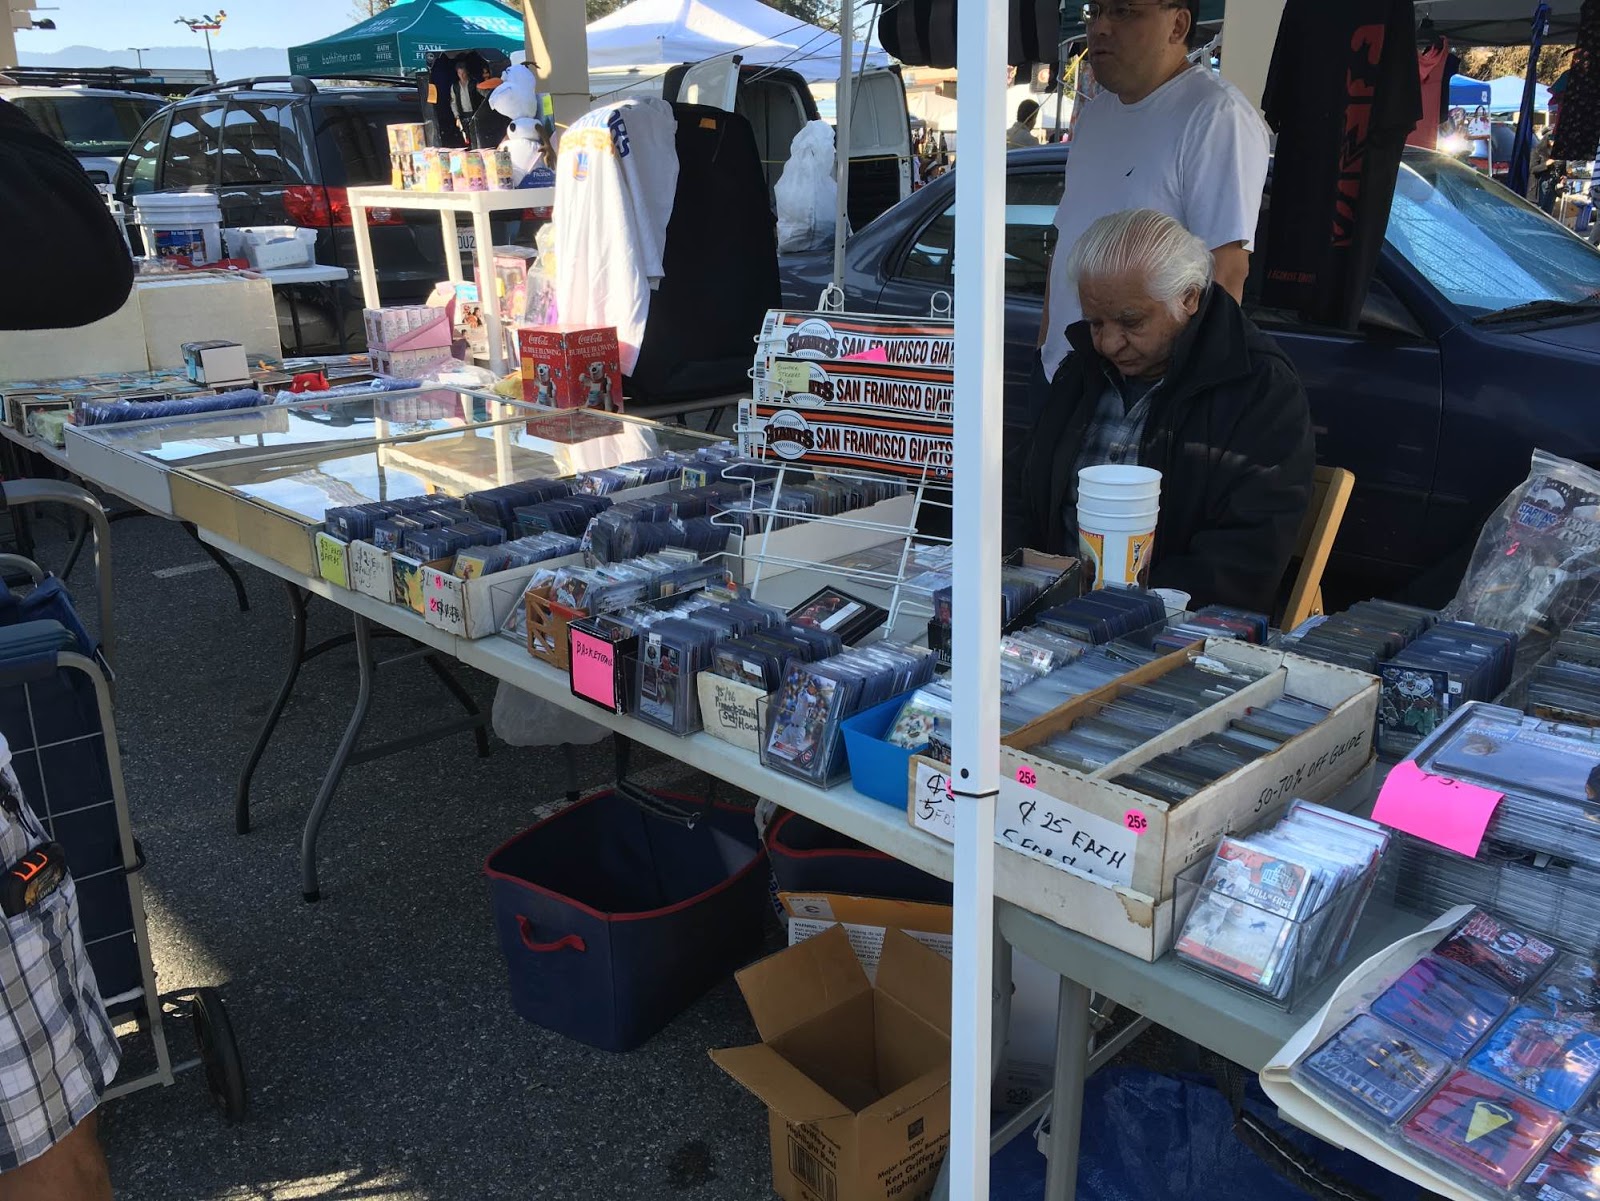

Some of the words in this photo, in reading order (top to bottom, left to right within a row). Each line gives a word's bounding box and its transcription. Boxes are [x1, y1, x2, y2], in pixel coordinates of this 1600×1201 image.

[321, 52, 362, 66] bathfitter.com
[418, 44, 443, 52] BATH
[864, 340, 929, 363] FRANCISCO
[836, 378, 861, 403] SAN
[864, 381, 924, 409] FRANCISCO
[816, 426, 840, 451] SAN
[843, 430, 906, 460] FRANCISCO
[908, 436, 954, 466] GIANTS
[1519, 503, 1557, 525] STARTING
[1018, 770, 1036, 785] 25¢
[1253, 763, 1306, 814] 50-70%
[1307, 754, 1328, 778] OFF
[1329, 730, 1366, 766] GUIDE
[1127, 814, 1147, 829] 25¢
[1072, 831, 1126, 869] EACH
[877, 1163, 899, 1181] Major
[899, 1147, 924, 1166] League
[885, 1172, 903, 1188] Ken
[904, 1151, 936, 1175] Griffey
[886, 1167, 927, 1199] Highlight
